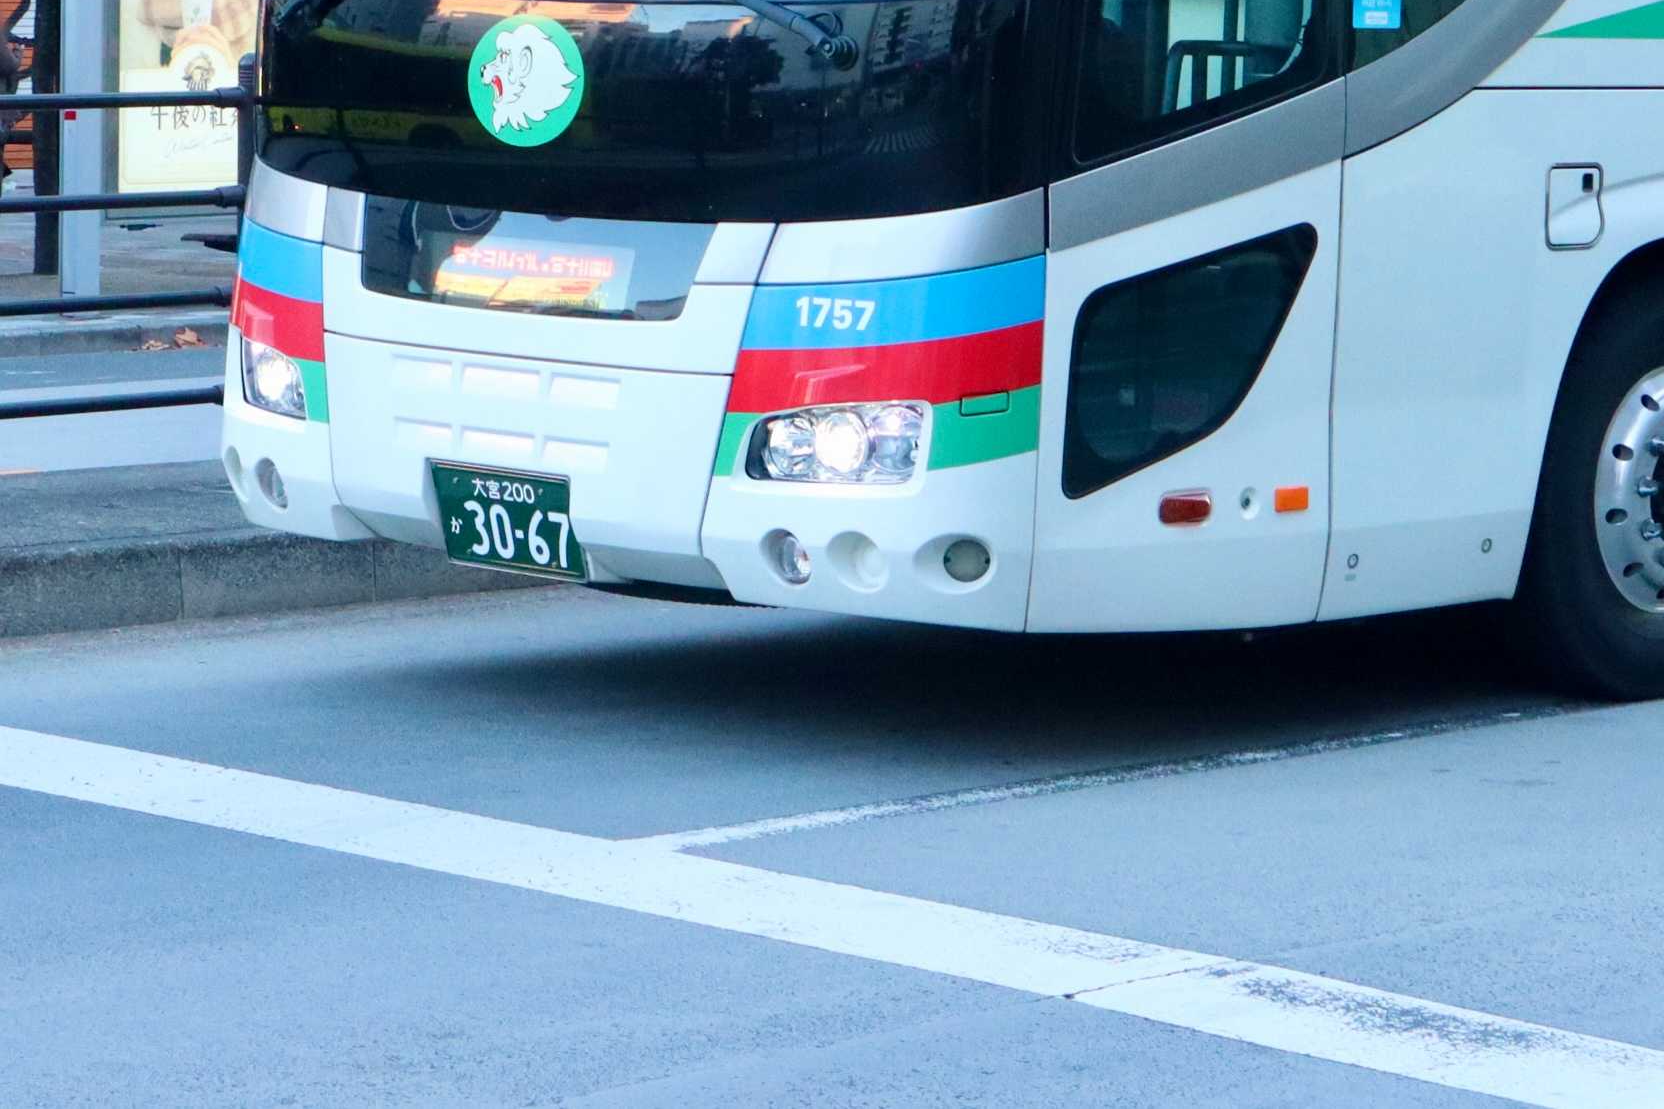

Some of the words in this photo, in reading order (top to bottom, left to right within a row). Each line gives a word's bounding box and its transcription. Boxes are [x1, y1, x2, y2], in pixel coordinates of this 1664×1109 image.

[795, 295, 877, 331] 1757
[450, 515, 463, 535] か
[463, 499, 570, 569] 30-67
